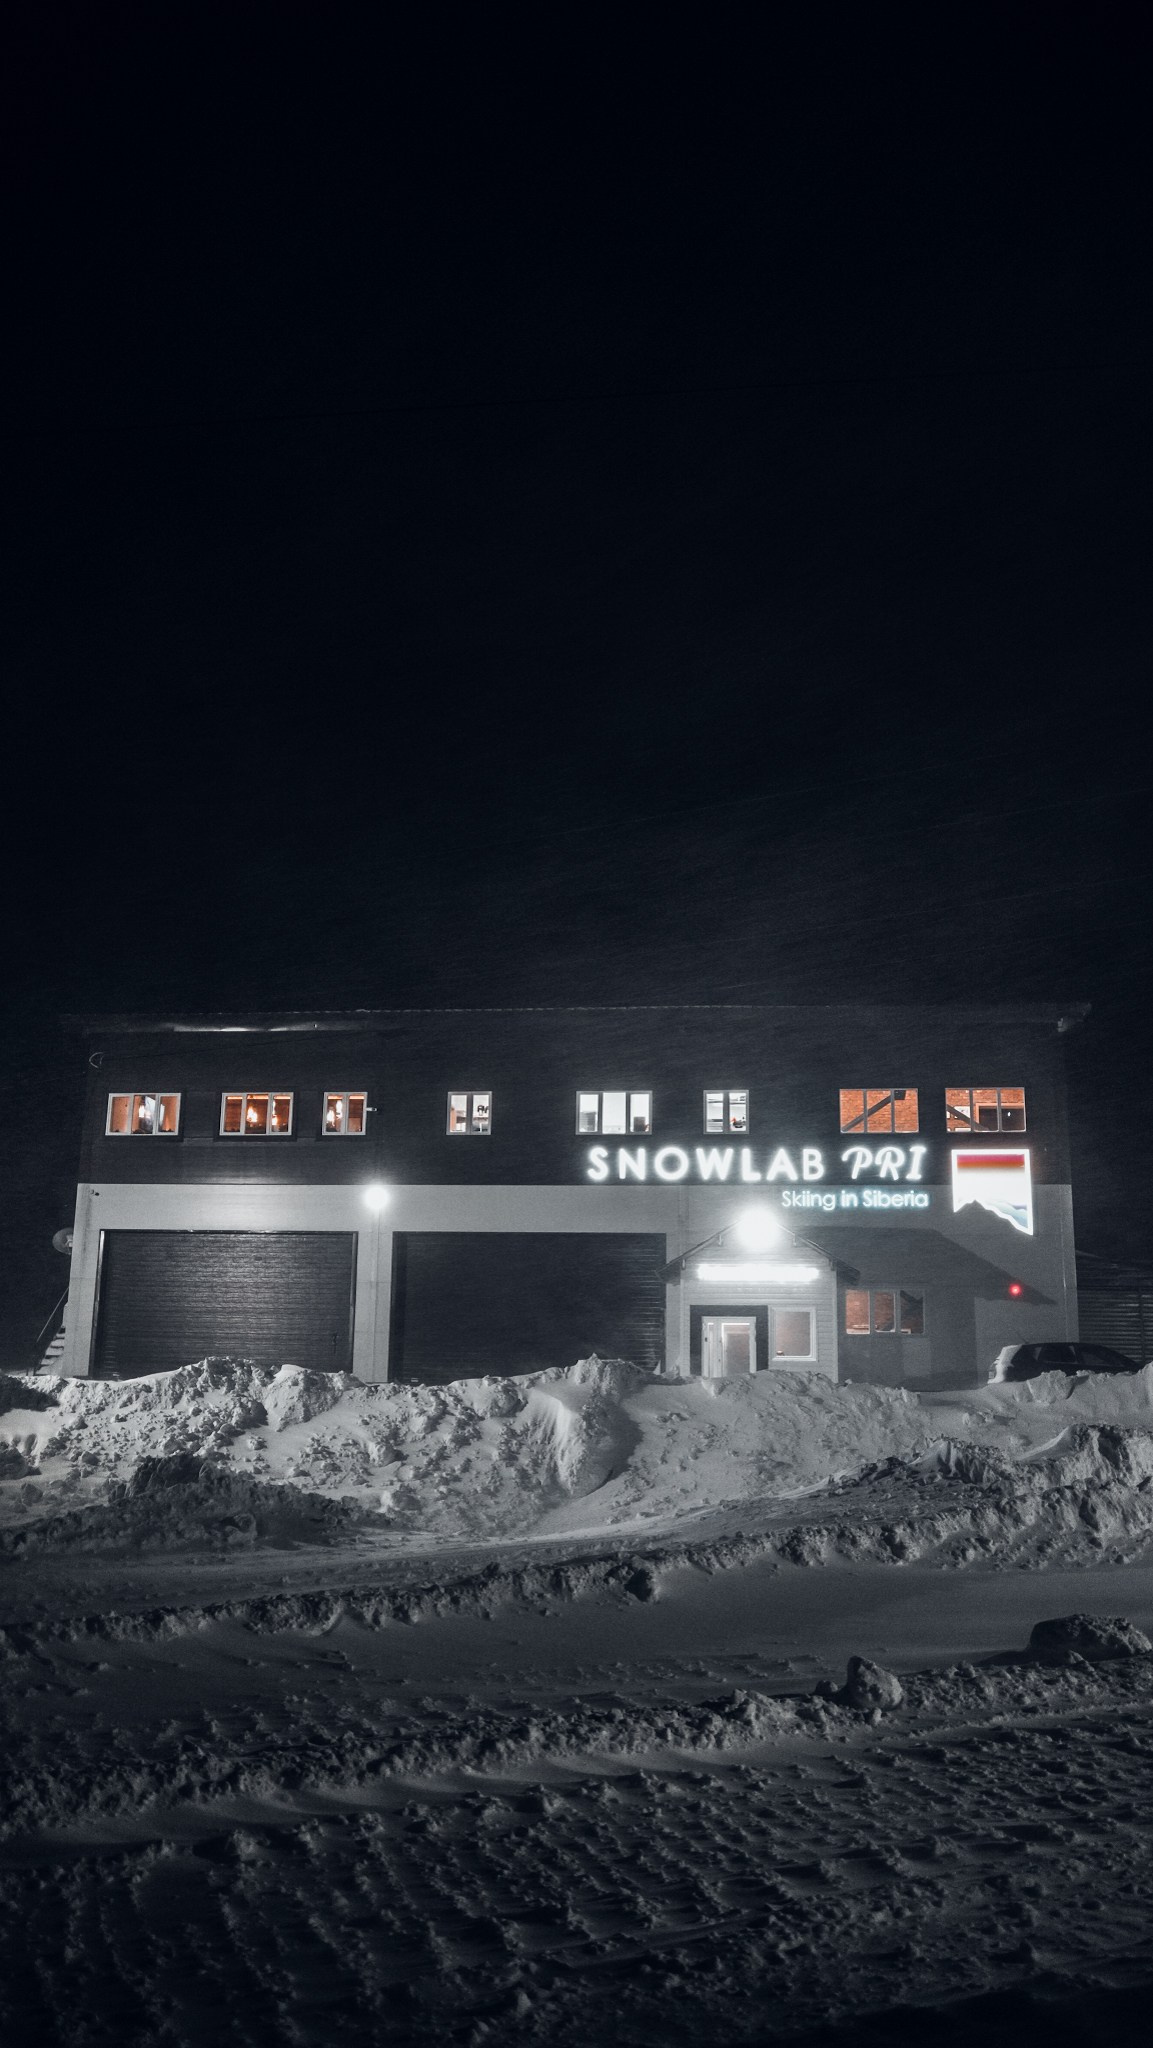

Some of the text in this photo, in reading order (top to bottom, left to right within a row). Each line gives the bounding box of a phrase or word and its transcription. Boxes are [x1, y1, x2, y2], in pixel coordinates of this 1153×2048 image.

[587, 1145, 928, 1181] SNOWLAB PRI
[781, 1190, 929, 1211] Skiing in Siberia
